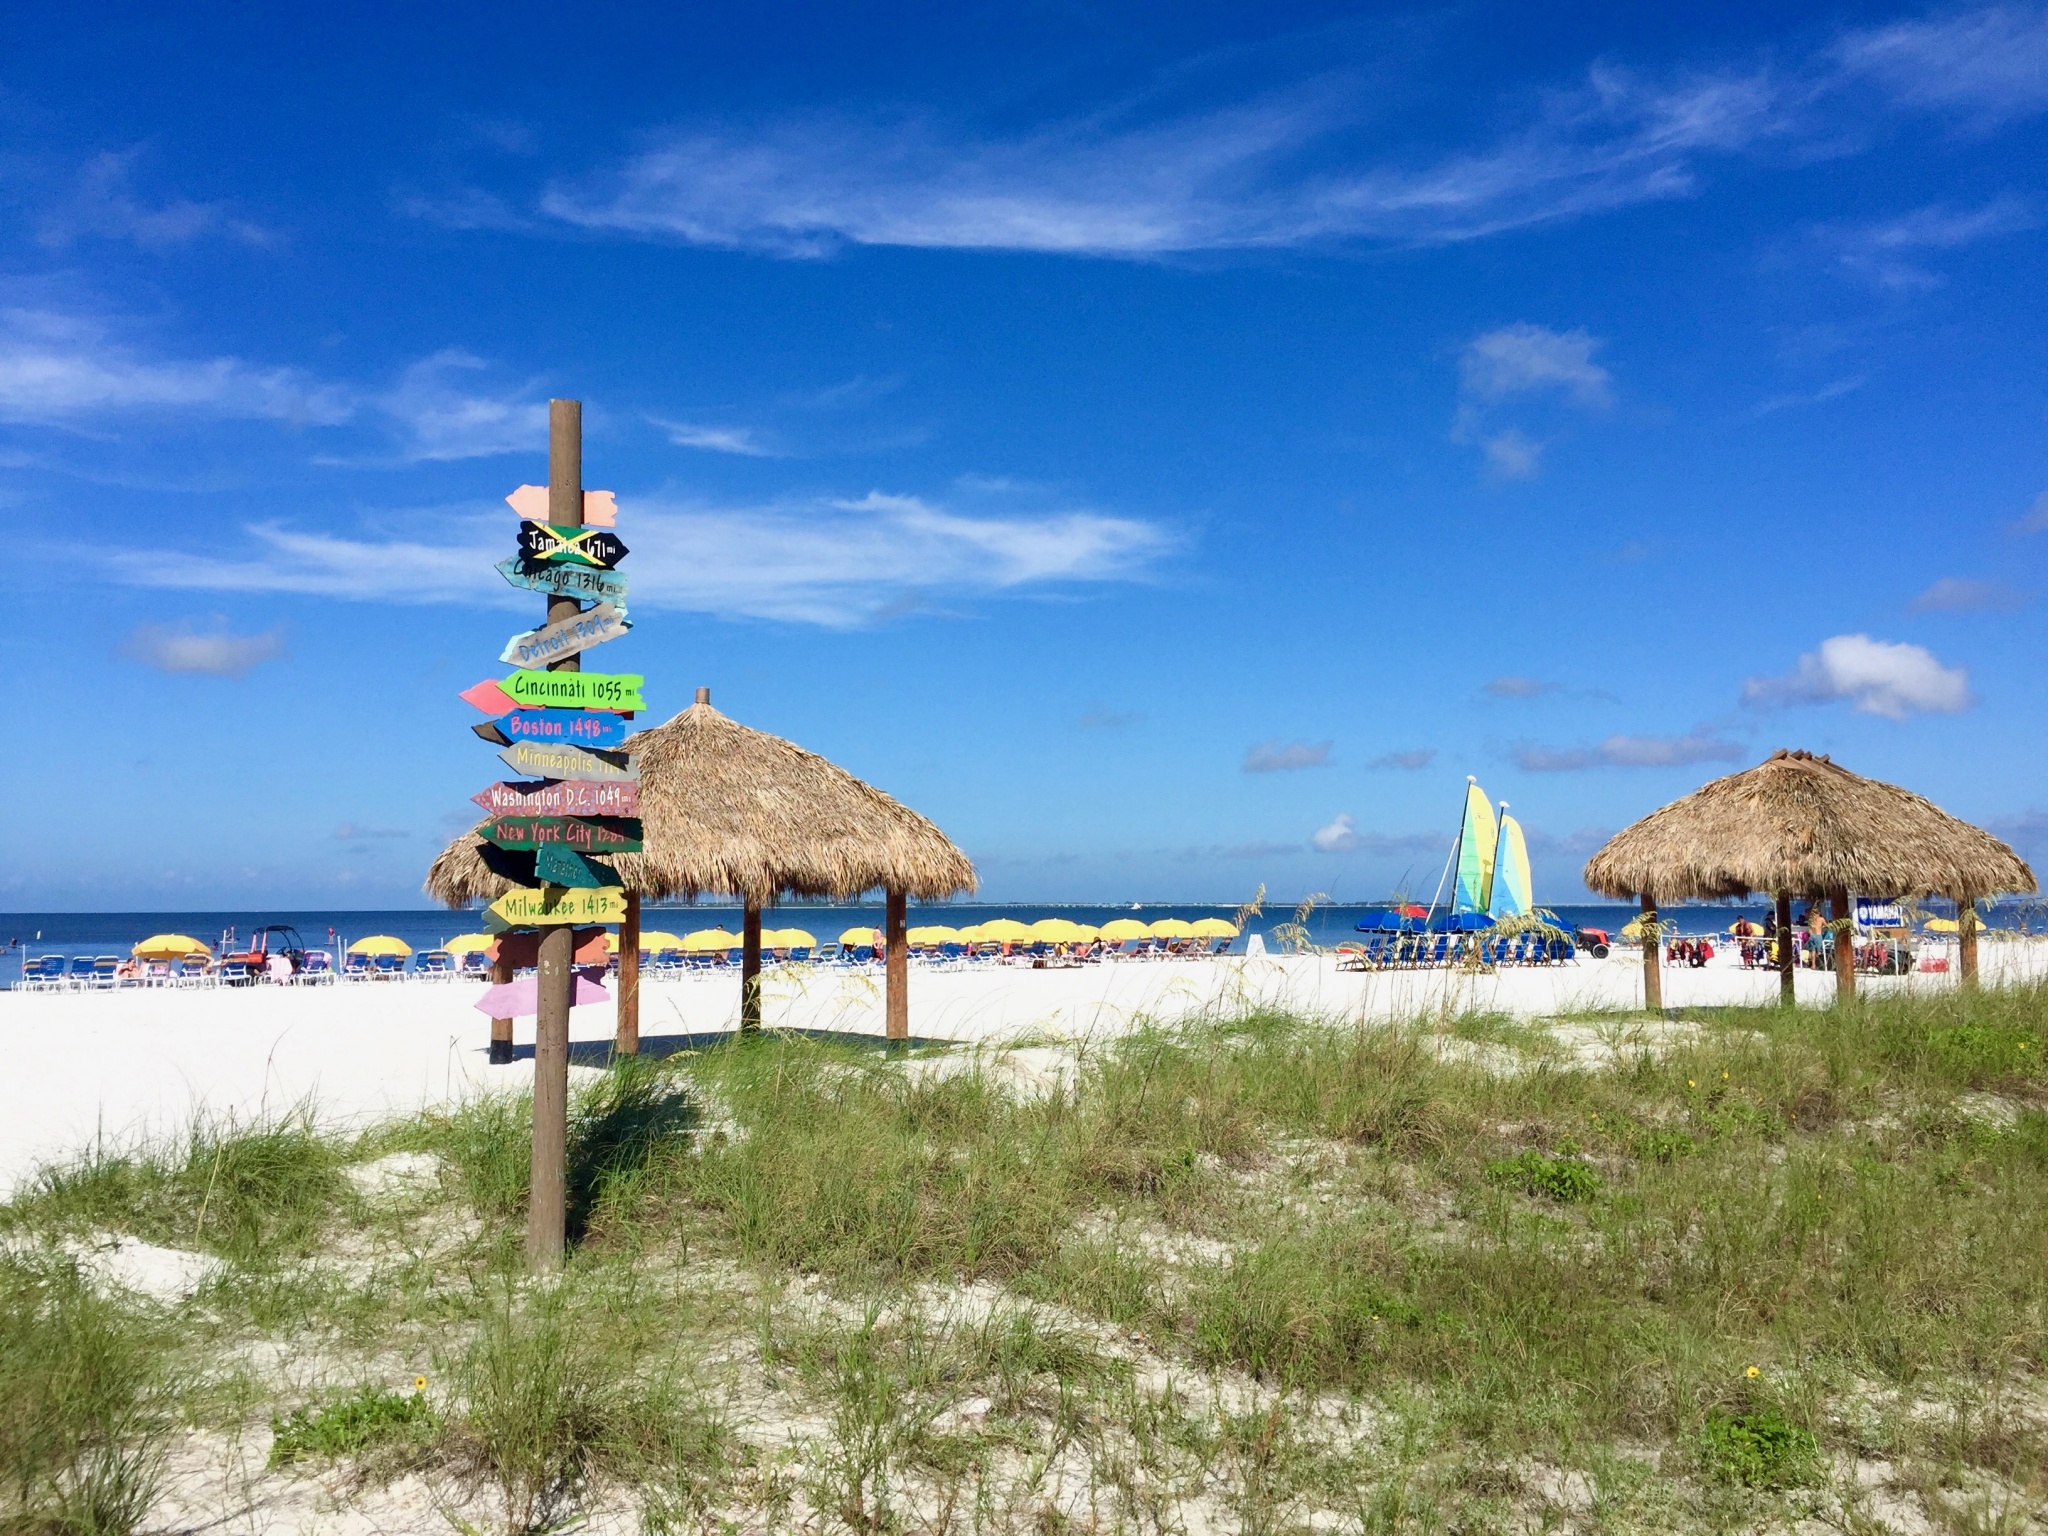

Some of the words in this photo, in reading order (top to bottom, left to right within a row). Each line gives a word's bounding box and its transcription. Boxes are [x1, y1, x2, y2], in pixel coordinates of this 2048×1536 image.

[528, 530, 582, 556] Jamaica
[587, 538, 607, 558] 671
[514, 558, 570, 592] Chicago
[577, 572, 605, 593] 1316
[518, 628, 570, 662] Detroit
[515, 676, 585, 699] Cincinnati
[592, 681, 622, 701] 1055
[625, 688, 635, 697] mi
[510, 715, 562, 735] Boston
[569, 716, 601, 738] 1498
[517, 747, 593, 776] Minneapolis
[491, 786, 560, 814] Washington
[566, 786, 591, 806] D.C.
[595, 785, 620, 808] 1049
[496, 823, 524, 840] New
[531, 823, 560, 842] York
[565, 823, 592, 850] City
[505, 897, 575, 916] Milwaukee
[582, 896, 608, 917] 1413
